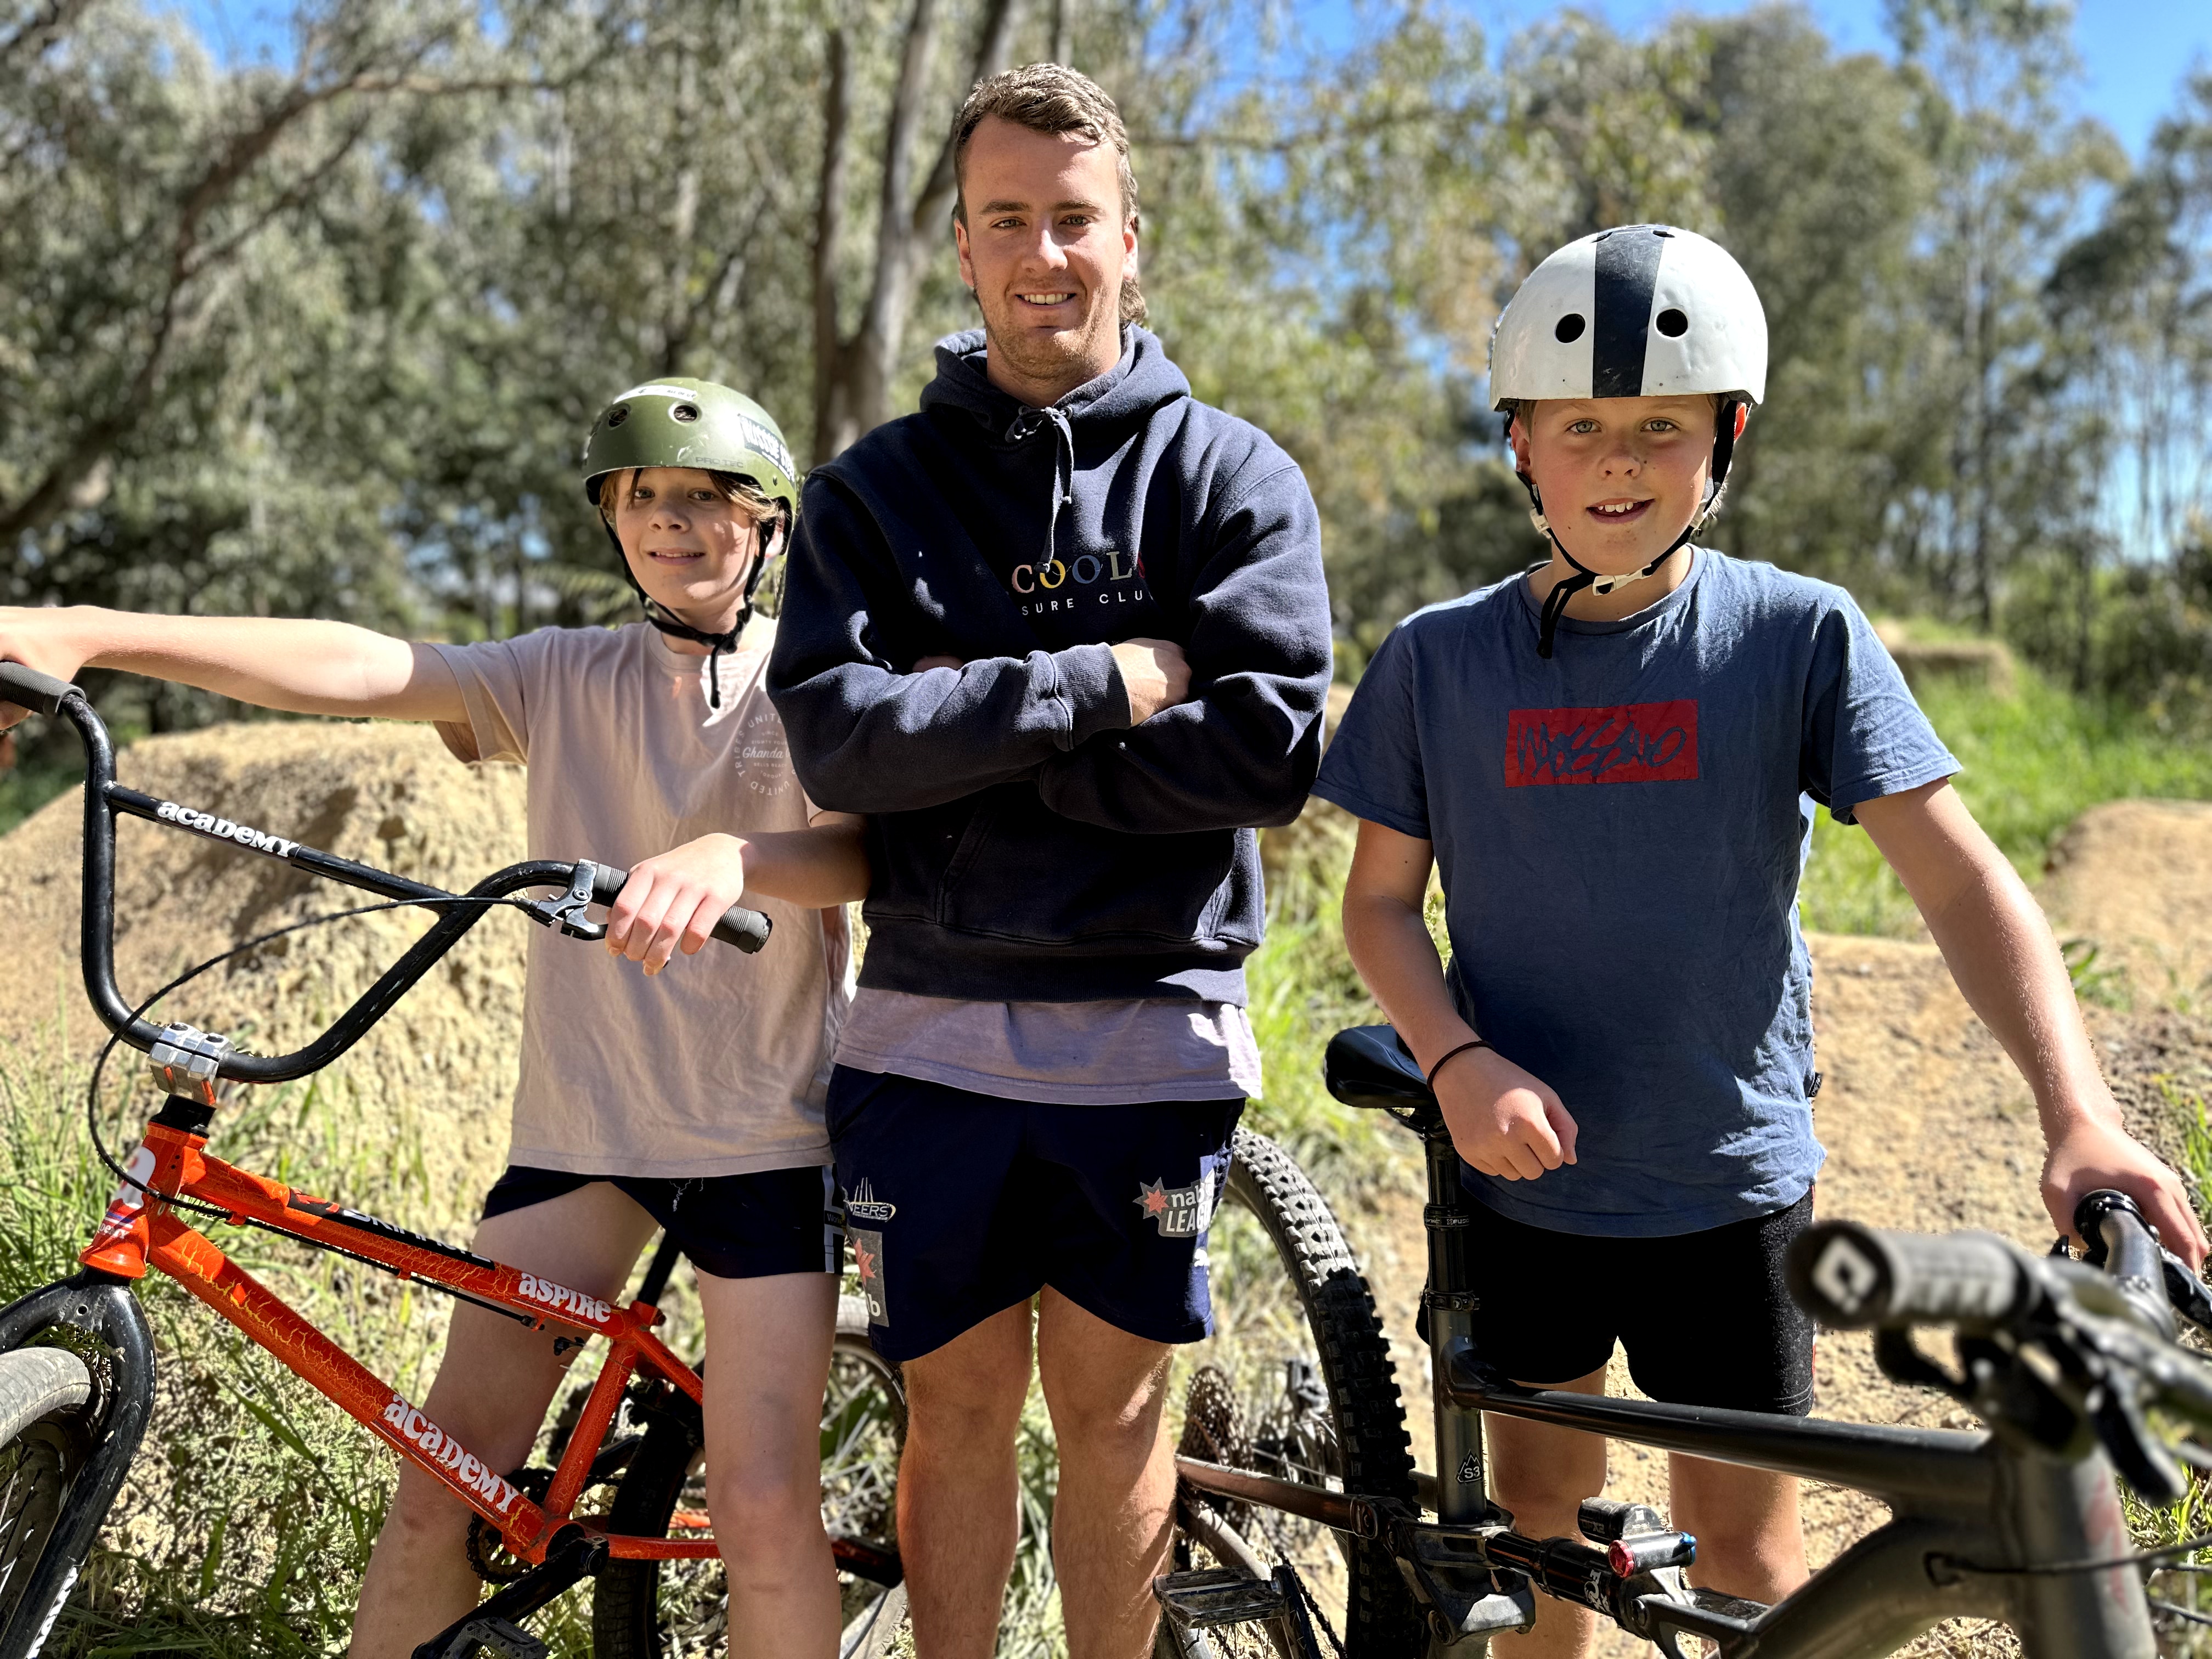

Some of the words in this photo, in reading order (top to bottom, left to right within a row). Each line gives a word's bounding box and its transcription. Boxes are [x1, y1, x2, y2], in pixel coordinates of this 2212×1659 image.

[1099, 589, 1154, 604] CLU
[747, 713, 782, 728] UNITE
[742, 746, 783, 759] Ghanda
[1166, 1199, 1213, 1232] LEAGU
[1464, 1466, 1480, 1479] S3
